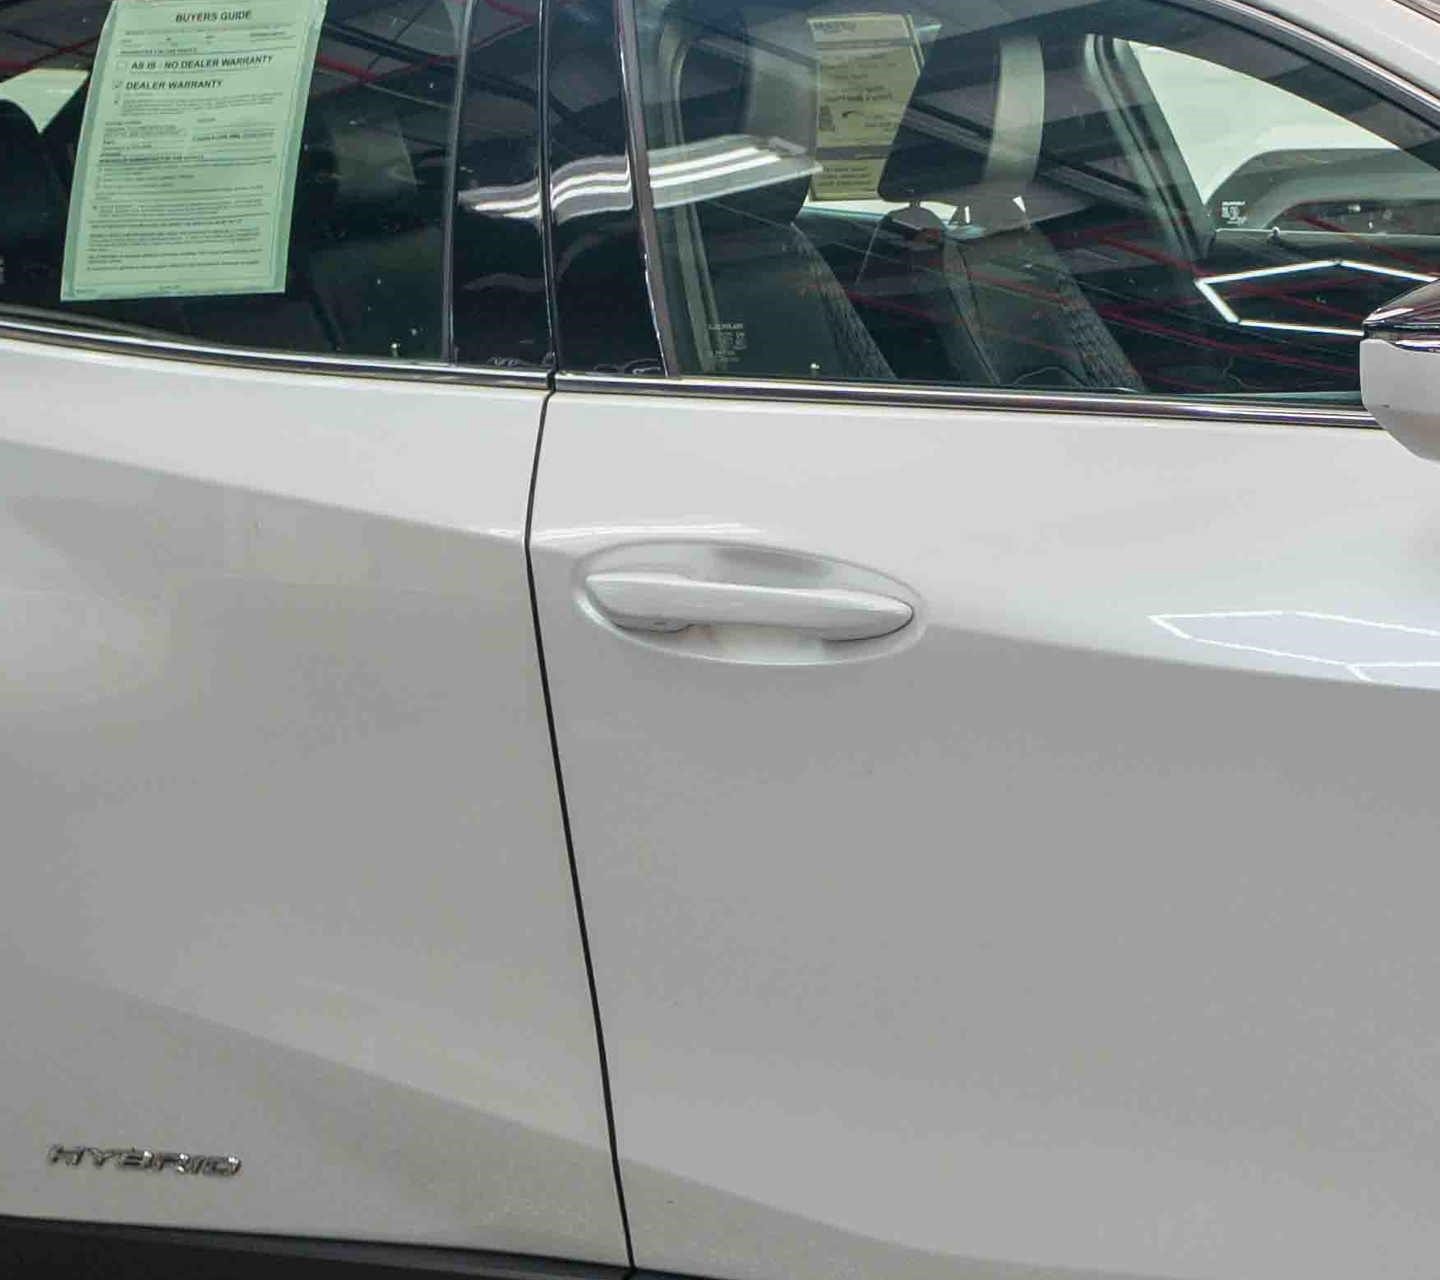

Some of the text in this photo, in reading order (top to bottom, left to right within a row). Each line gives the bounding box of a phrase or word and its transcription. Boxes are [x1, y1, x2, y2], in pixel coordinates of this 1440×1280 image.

[175, 10, 252, 23] BUYERS GUIDE
[164, 60, 180, 70] NO
[180, 58, 220, 69] DEALER
[221, 55, 274, 67] WARRANTY
[125, 79, 224, 90] DEALER WARRANTY
[48, 1145, 242, 1176] HYBRID
